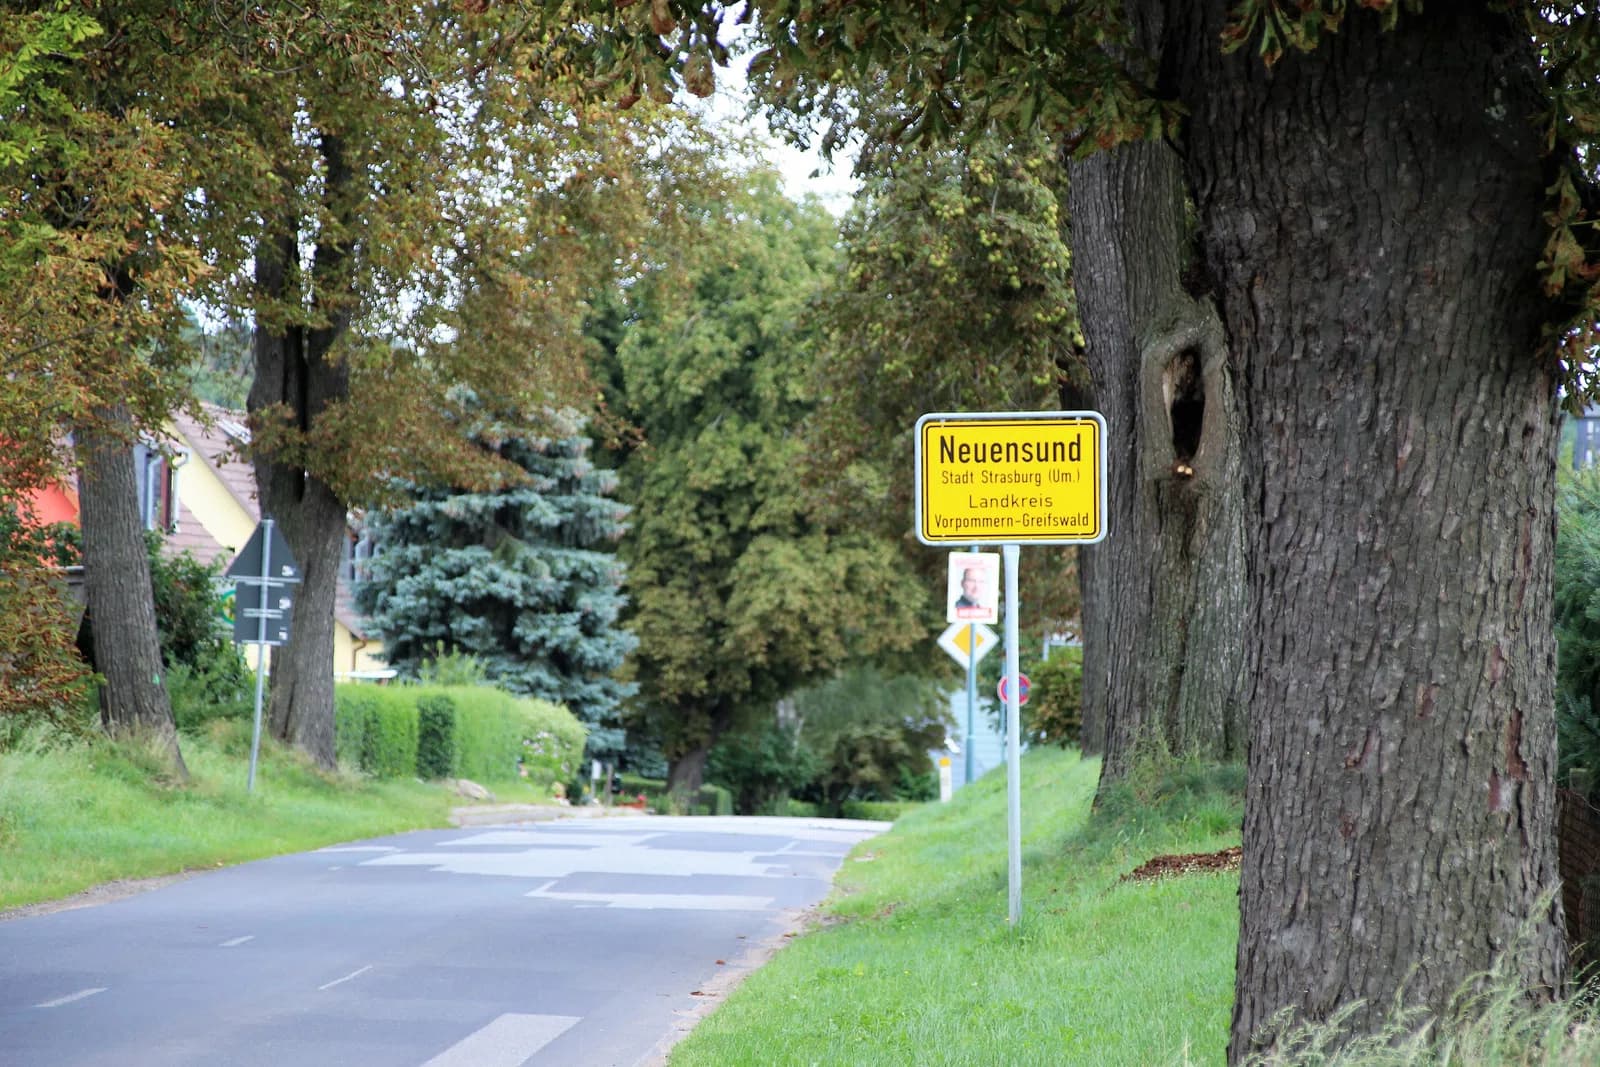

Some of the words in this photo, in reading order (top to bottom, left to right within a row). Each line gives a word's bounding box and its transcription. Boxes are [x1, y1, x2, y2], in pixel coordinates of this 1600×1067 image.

[940, 433, 1081, 464] Neuensund
[942, 469, 974, 485] Stadt
[981, 469, 1042, 487] Strasburg
[1048, 468, 1081, 484] (Um.)
[969, 493, 1053, 509] Landkreis
[934, 512, 1089, 532] Vorpommern-Greifswald
